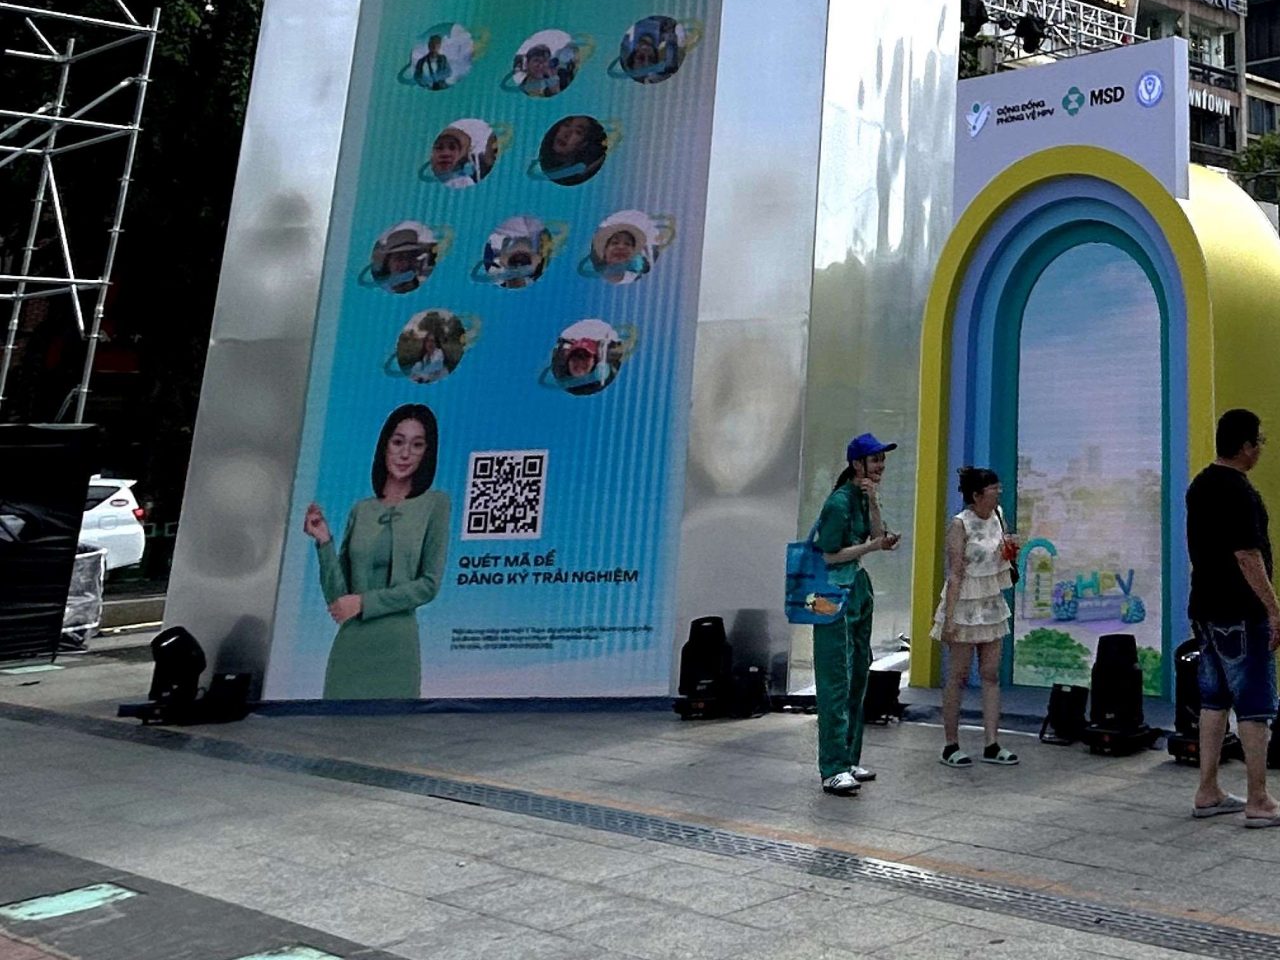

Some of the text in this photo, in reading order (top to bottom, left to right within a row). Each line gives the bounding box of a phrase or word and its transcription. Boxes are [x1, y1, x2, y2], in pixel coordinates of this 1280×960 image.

[1090, 86, 1125, 107] MSD
[459, 549, 556, 569] QUÉT MÃ ĐỂ
[457, 567, 639, 586] ĐĂNG KÝ TRẢI NGHIỆM
